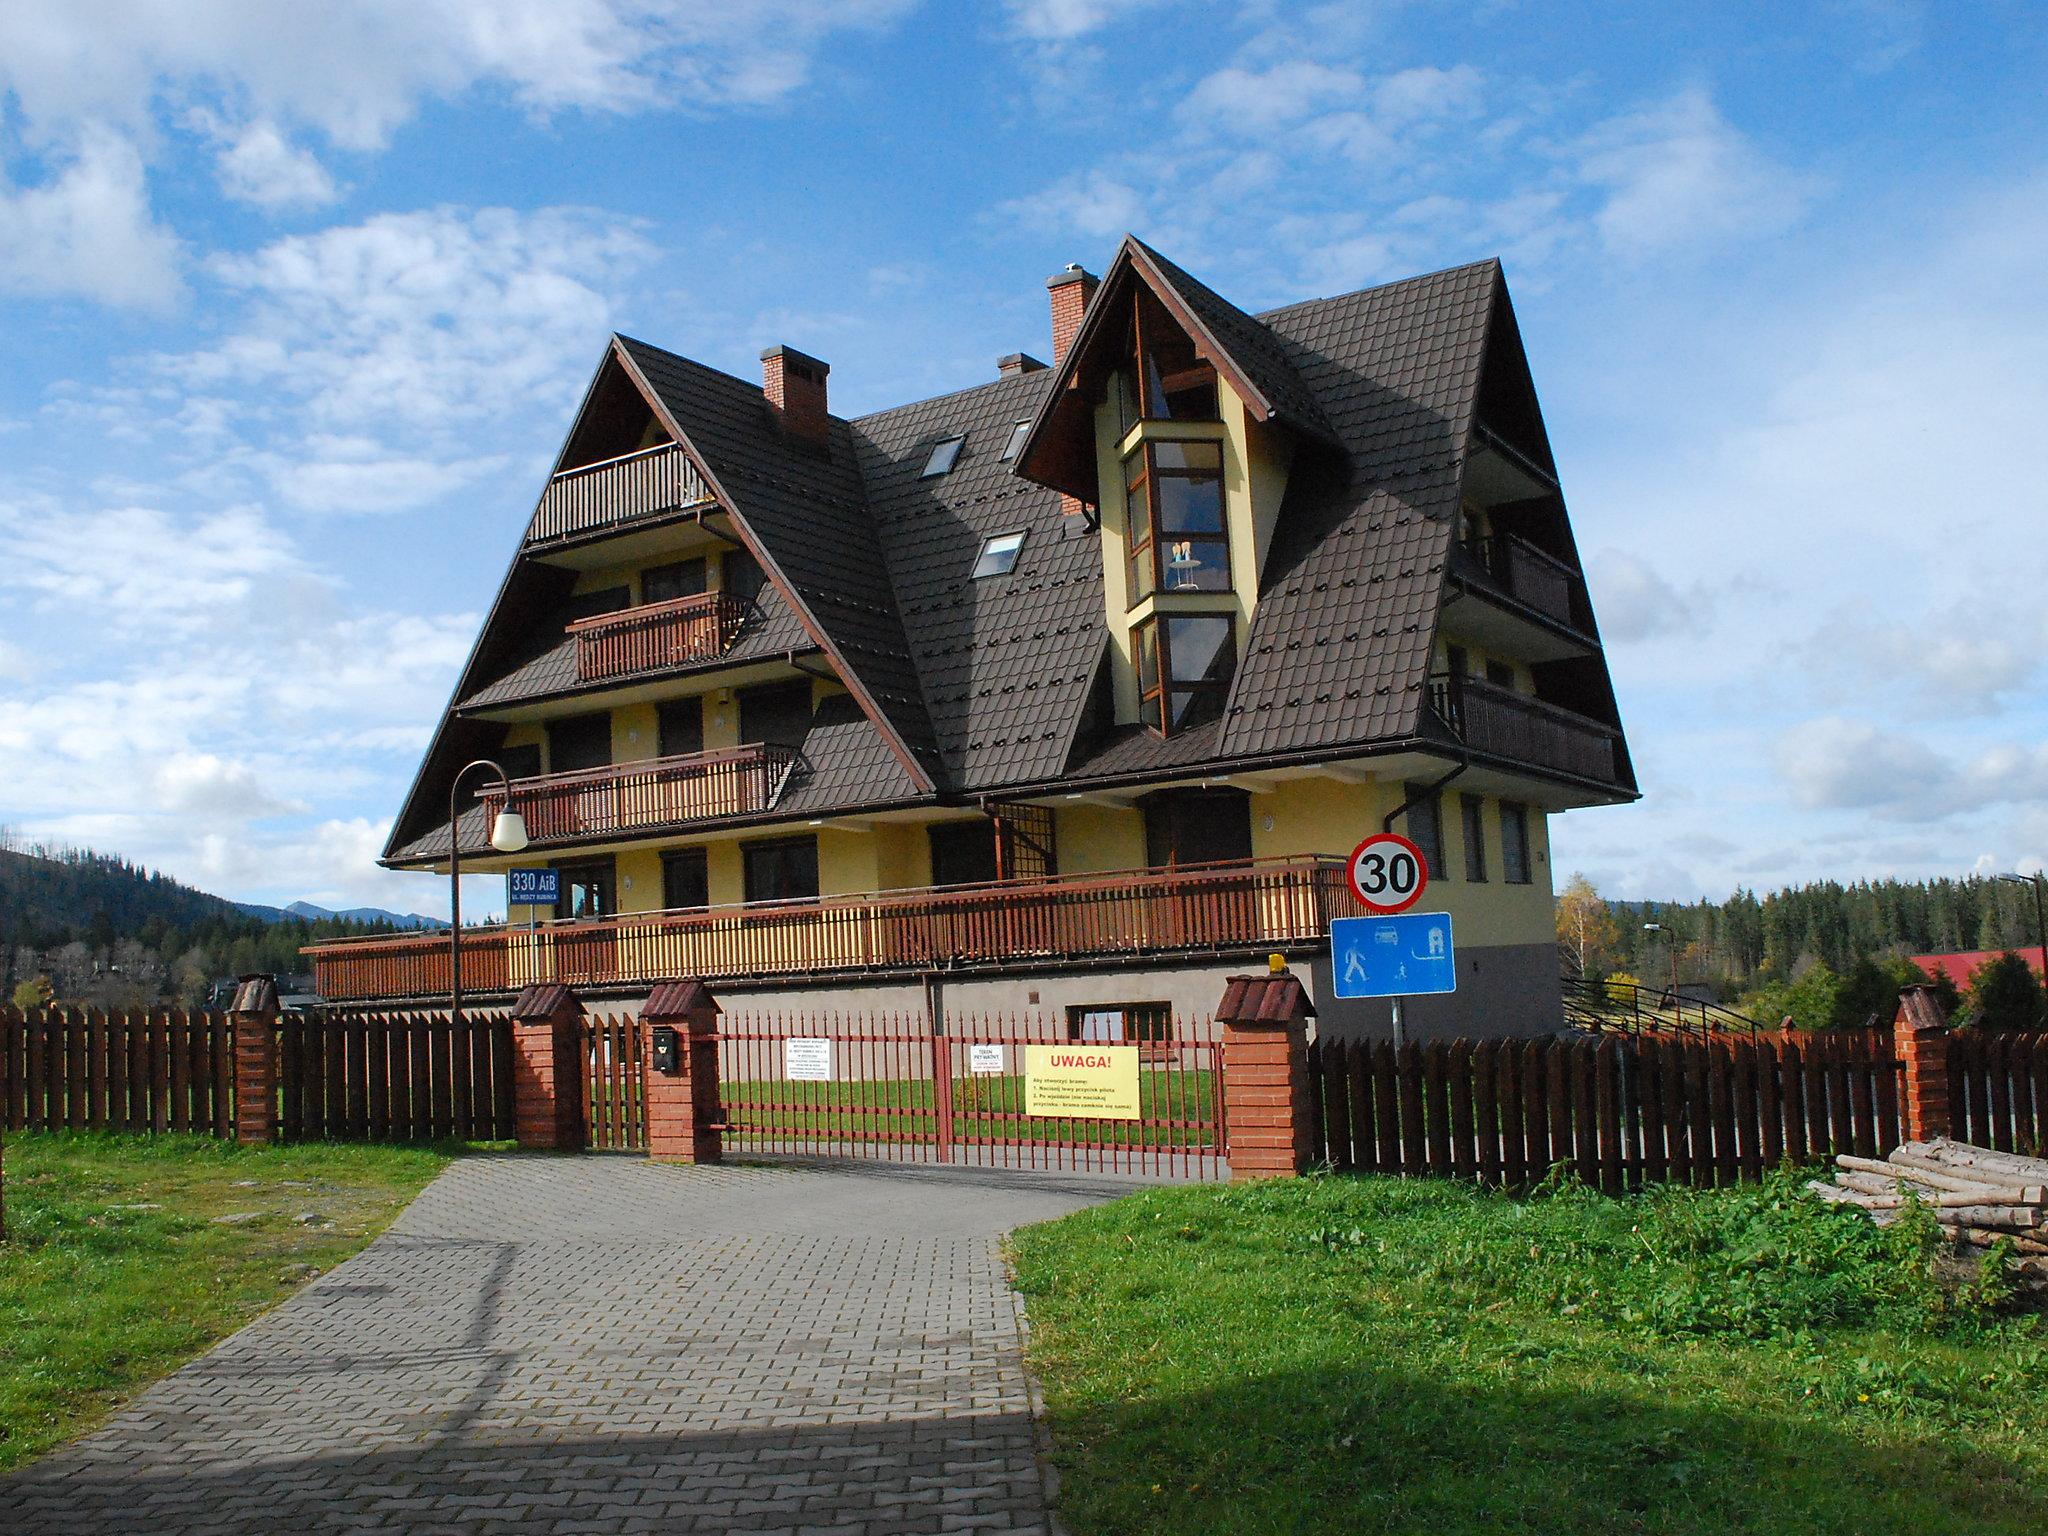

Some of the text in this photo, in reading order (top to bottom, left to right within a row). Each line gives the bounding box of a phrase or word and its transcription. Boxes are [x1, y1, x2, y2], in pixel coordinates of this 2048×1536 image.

[513, 873, 556, 890] 330 AiB
[1360, 853, 1415, 894] 30
[1051, 1055, 1111, 1068] UWAGA!
